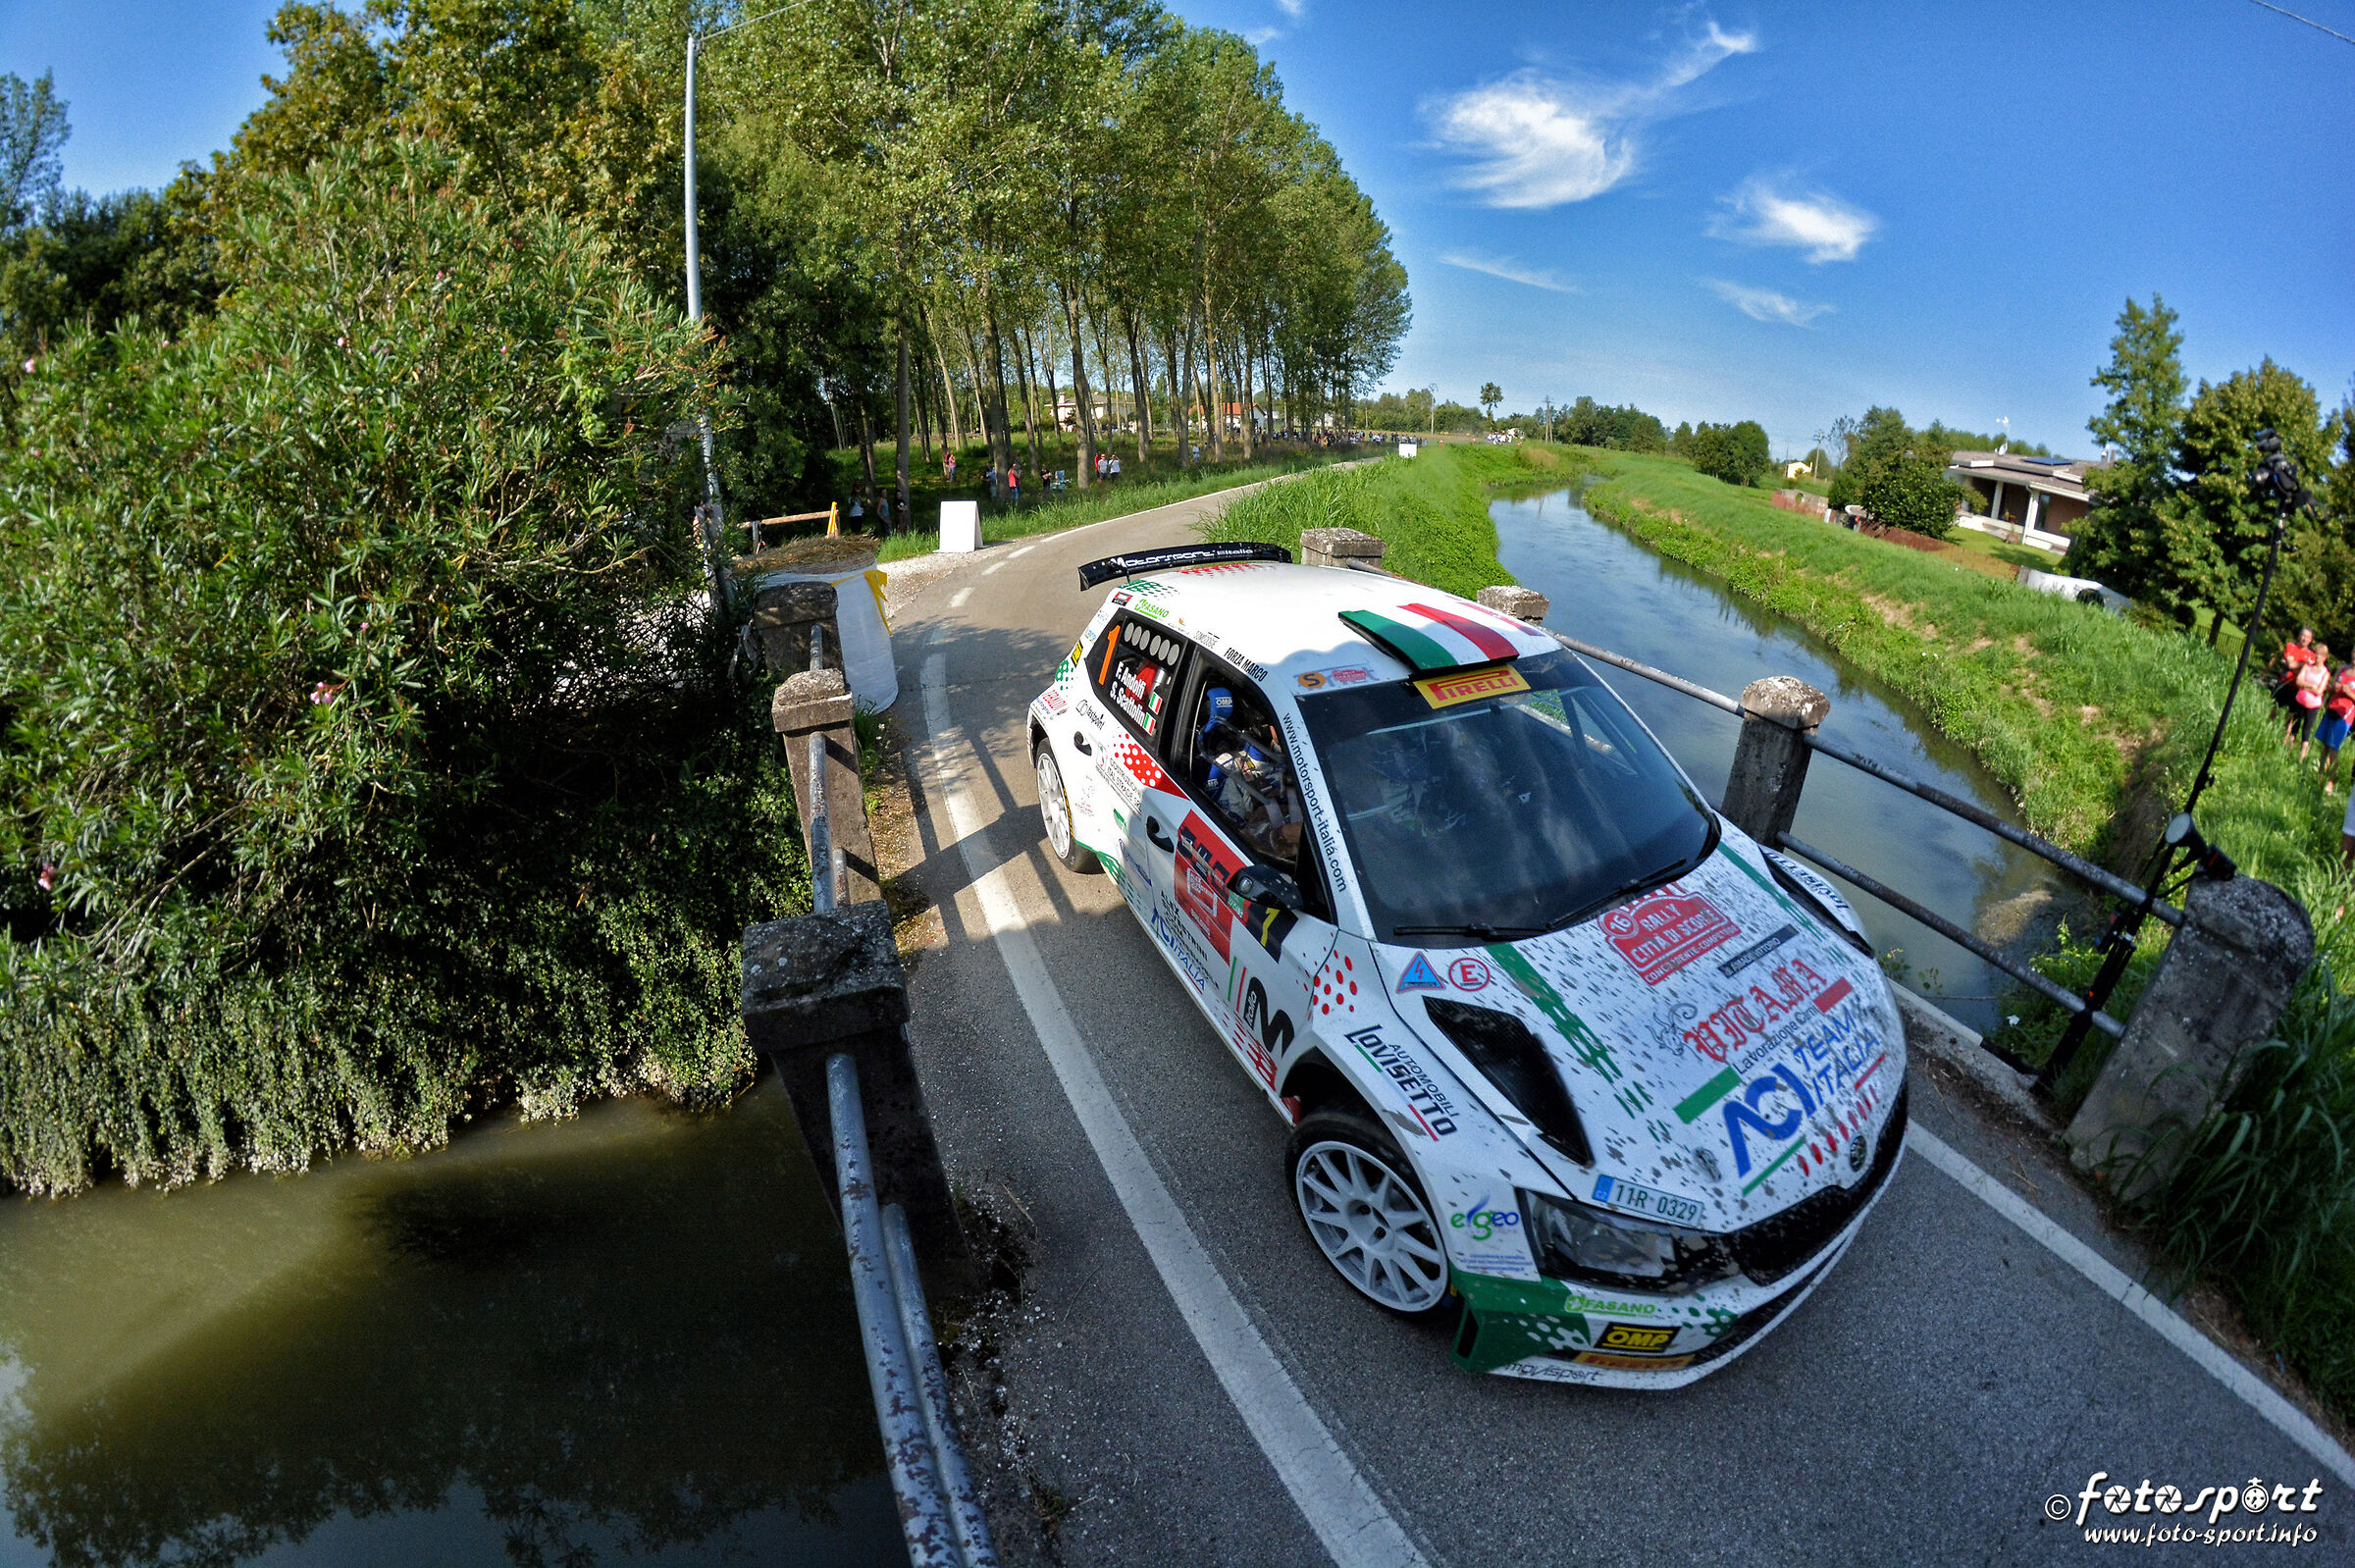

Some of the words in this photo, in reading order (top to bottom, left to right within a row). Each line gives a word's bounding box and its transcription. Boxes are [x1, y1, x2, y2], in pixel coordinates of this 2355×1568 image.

[1108, 549, 1215, 567] Motorsport
[1142, 601, 1170, 618] FASANO
[1099, 624, 1122, 686] 1
[1224, 648, 1245, 667] FORZA
[1241, 658, 1269, 682] MARCO
[1116, 661, 1124, 679] F.
[1120, 666, 1147, 700] Andolfi
[1428, 669, 1519, 702] PIRELLI
[1110, 681, 1119, 701] S.
[1116, 687, 1147, 727] Scattolin
[1282, 712, 1347, 893] www.motorsport-italia.com
[1260, 907, 1281, 947] 1
[1609, 915, 1632, 933] 16
[1640, 903, 1682, 933] RALLY
[1664, 927, 1684, 944] DI
[1174, 945, 1206, 991] ITALIA
[1460, 964, 1479, 983] E
[1733, 1020, 1804, 1075] Lavorazione
[1794, 1004, 1858, 1072] TEAM
[1343, 1023, 1458, 1136] LOVISETTO
[1388, 1043, 1460, 1118] AUTOMOBILI
[1811, 1027, 1880, 1106] ITALIA
[1616, 1183, 1648, 1210] 11R
[1656, 1196, 1698, 1222] 0329
[1585, 1298, 1656, 1315] FASANO
[1606, 1330, 1670, 1347] OMP
